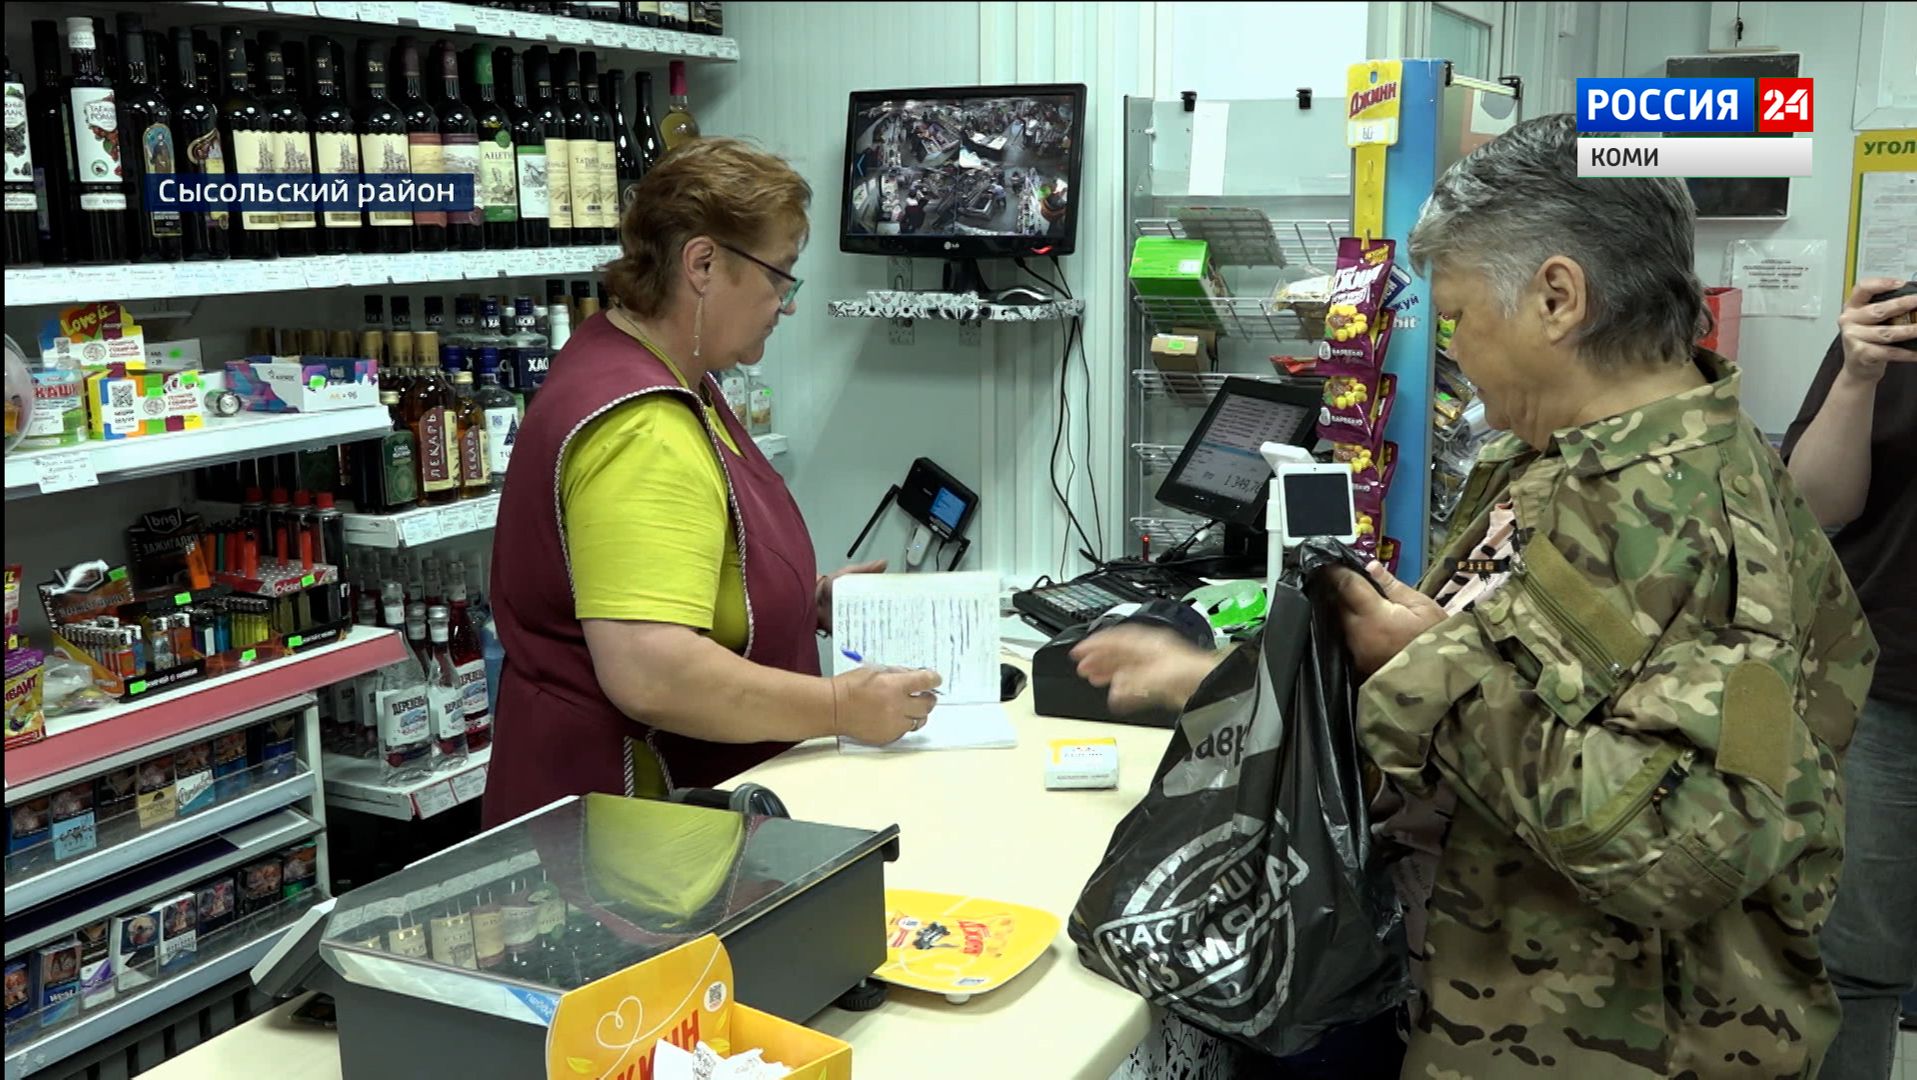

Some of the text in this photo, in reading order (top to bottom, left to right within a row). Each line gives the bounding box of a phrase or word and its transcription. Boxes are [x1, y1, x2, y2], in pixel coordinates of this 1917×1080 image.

[1863, 140, 1917, 156] УГОЛ
[61, 312, 97, 336] Love
[528, 358, 550, 373] ХАО
[427, 413, 442, 479] ЛЕКАРЬ
